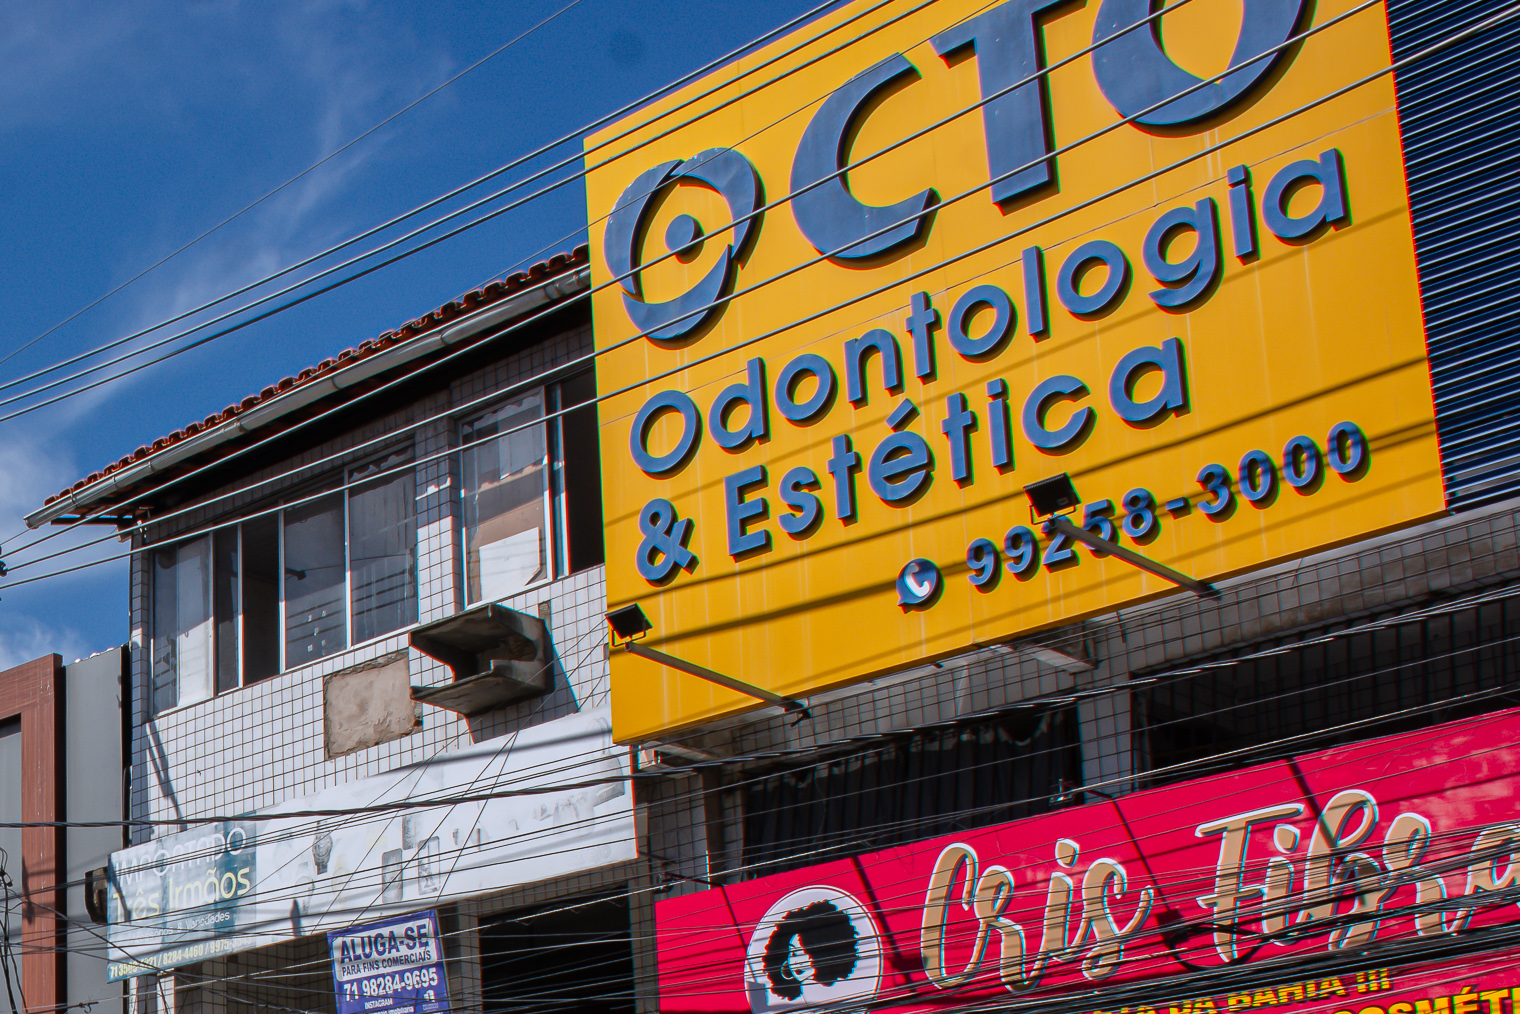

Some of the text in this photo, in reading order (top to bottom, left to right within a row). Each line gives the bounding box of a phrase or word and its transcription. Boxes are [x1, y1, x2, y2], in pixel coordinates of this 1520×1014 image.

[629, 146, 1352, 478] Odontologia
[635, 336, 1192, 584] & Estética
[169, 867, 251, 910] Irmãos
[921, 838, 1154, 994] Cris
[340, 924, 430, 964] ALUGA-SE
[342, 950, 431, 977] PARA FINS COMERCIAIS
[343, 967, 438, 1002] 71 98284-9695
